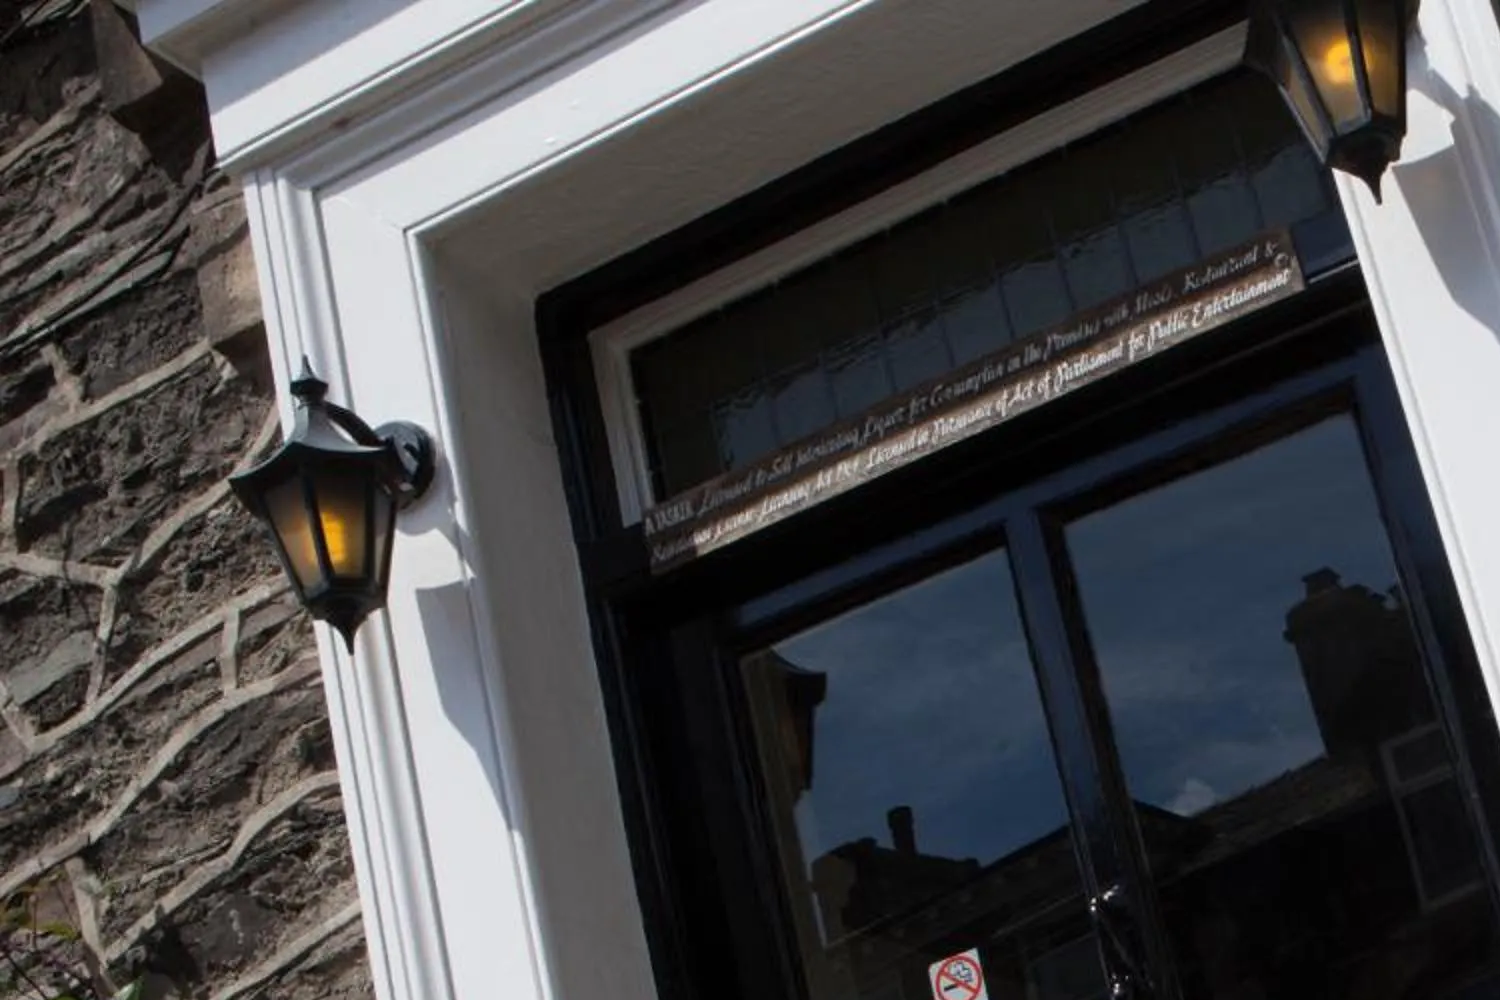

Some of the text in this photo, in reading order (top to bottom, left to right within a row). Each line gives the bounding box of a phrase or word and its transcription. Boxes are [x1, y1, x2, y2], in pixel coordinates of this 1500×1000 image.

[1007, 376, 1033, 407] Act
[1053, 335, 1123, 393] Parliament
[1128, 325, 1144, 362] for
[1146, 306, 1186, 351] Public
